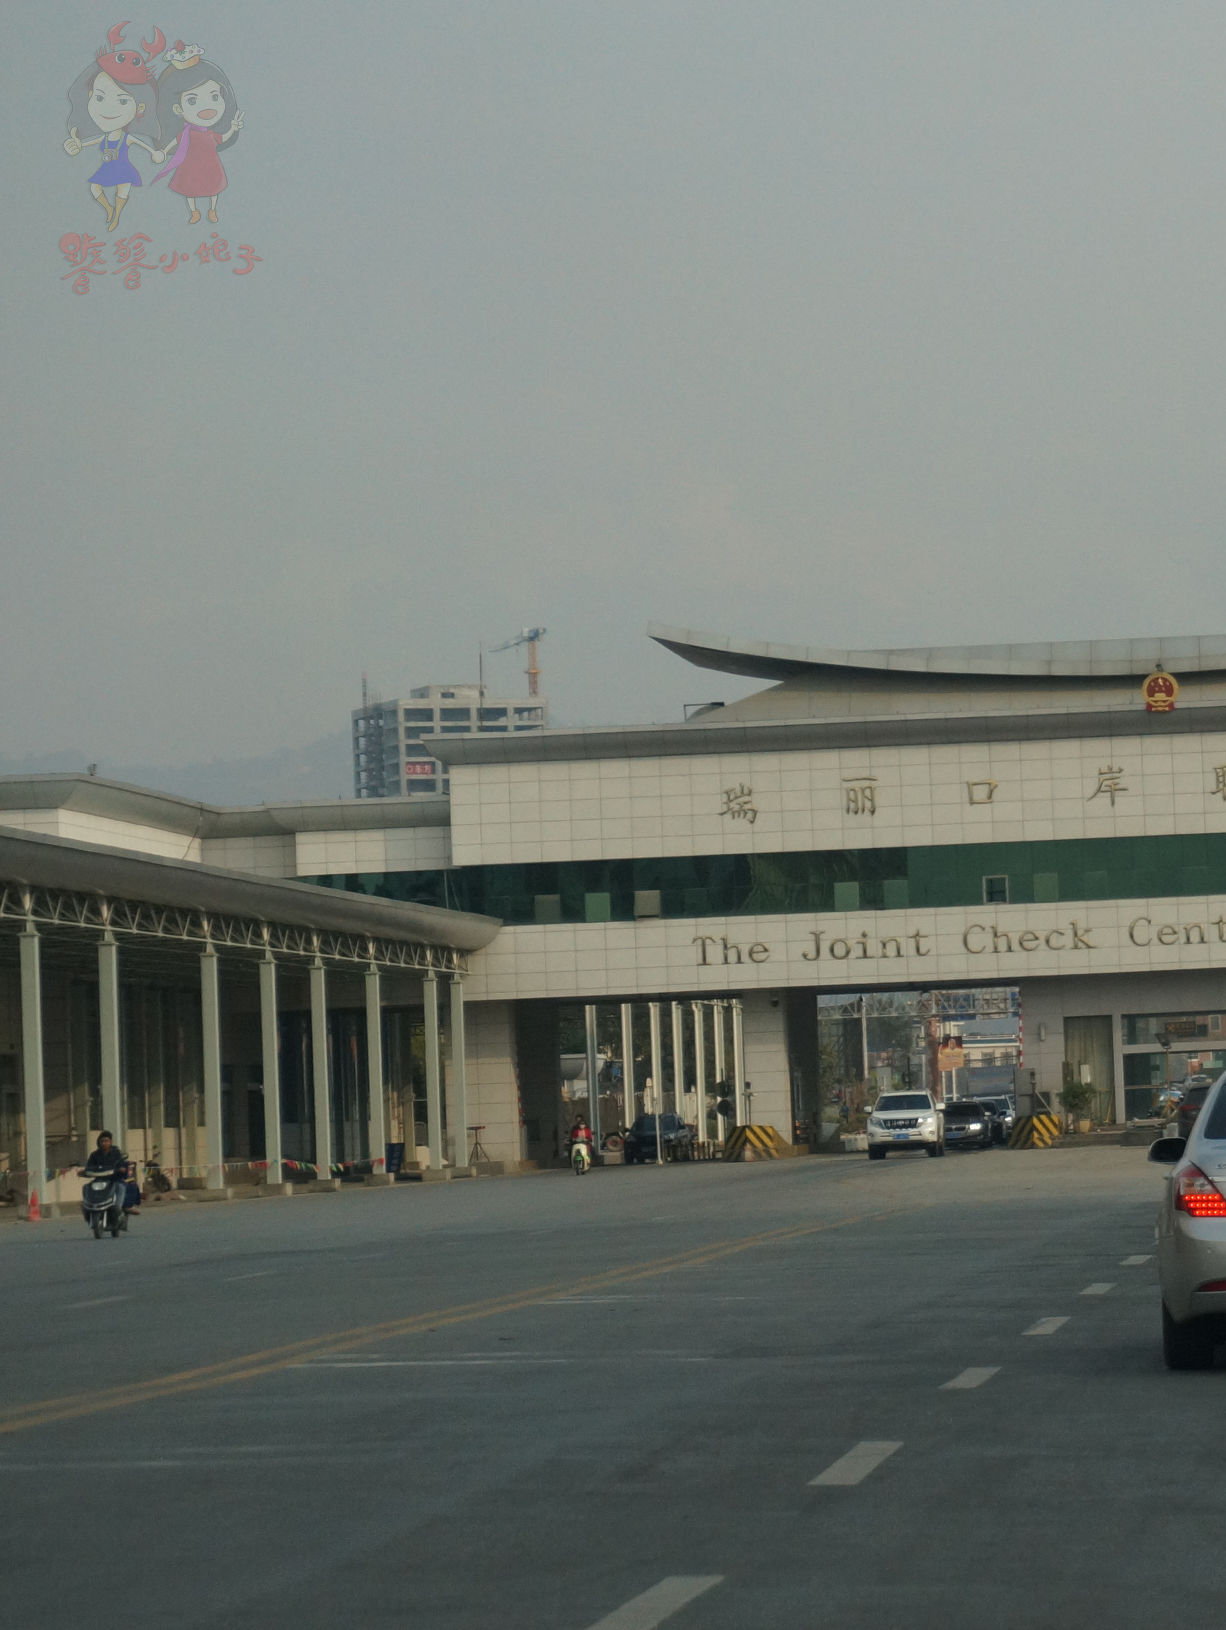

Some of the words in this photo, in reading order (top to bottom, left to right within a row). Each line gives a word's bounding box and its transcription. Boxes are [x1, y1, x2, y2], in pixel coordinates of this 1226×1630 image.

[692, 936, 771, 967] The
[802, 930, 932, 963] Joint
[962, 920, 1098, 955] Check
